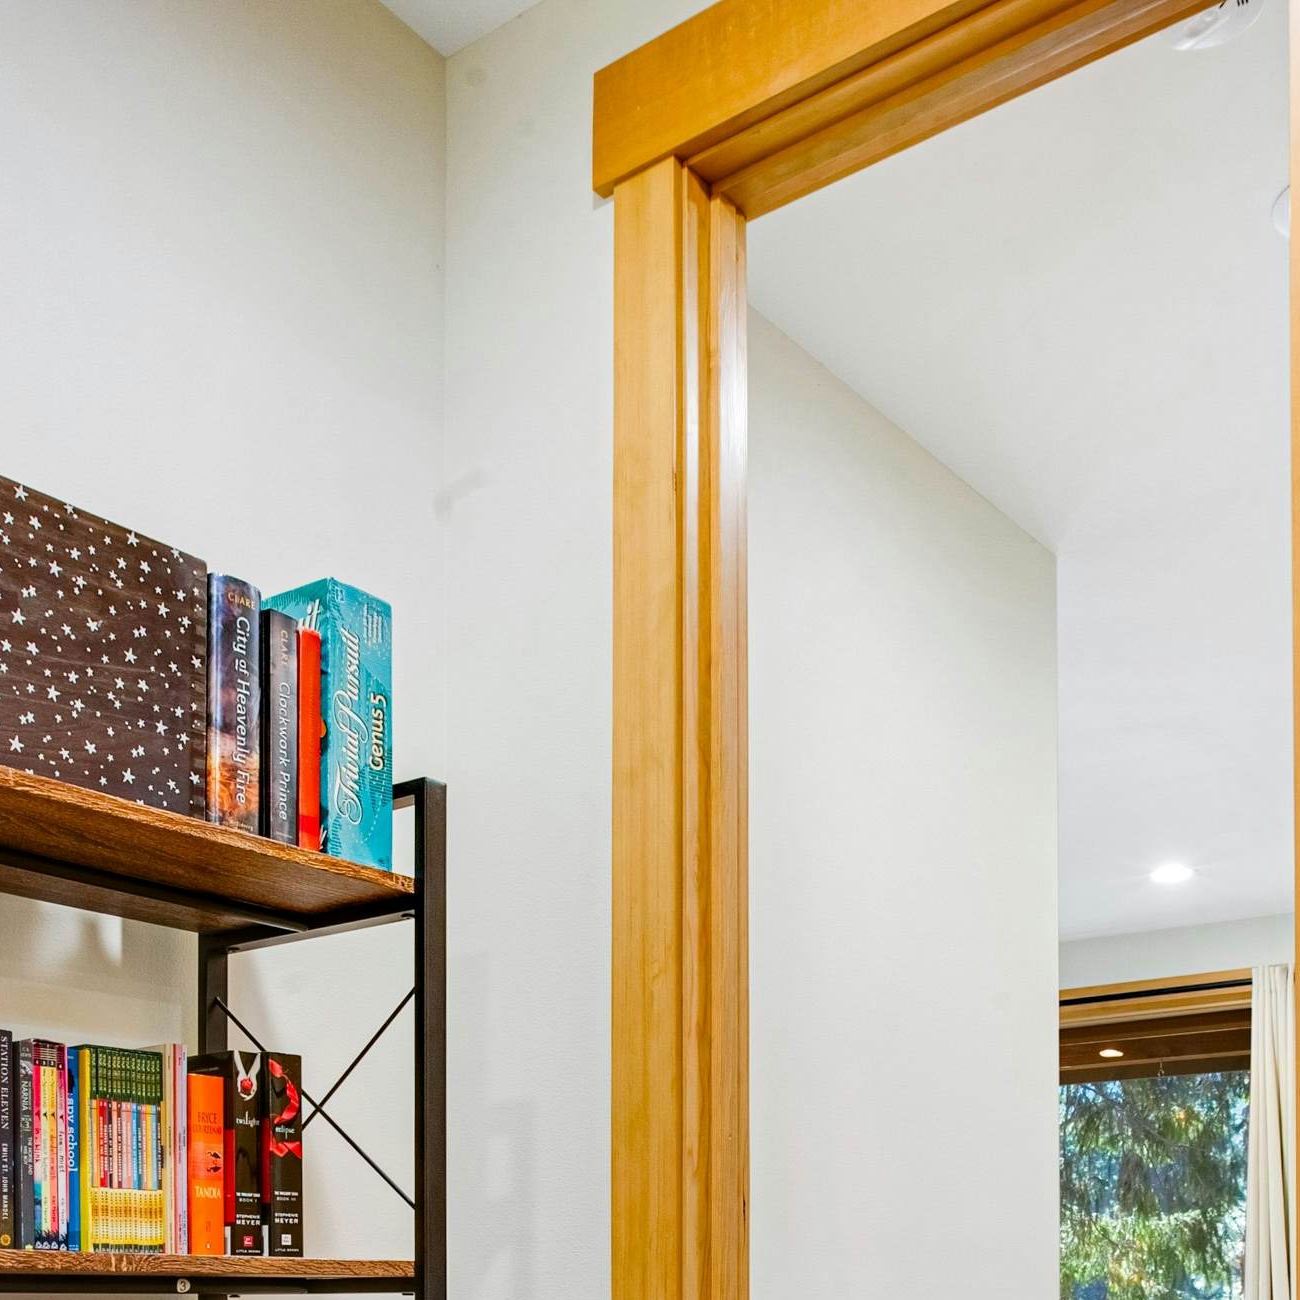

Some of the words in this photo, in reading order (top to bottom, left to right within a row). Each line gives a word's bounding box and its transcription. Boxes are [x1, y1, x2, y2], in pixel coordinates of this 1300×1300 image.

[233, 616, 251, 656] City
[235, 659, 251, 676] of
[332, 624, 369, 744] Pursuit
[370, 692, 388, 708] 5
[232, 679, 250, 765] Heavenly
[279, 682, 291, 767] Clockwork
[369, 709, 385, 771] Genus
[235, 769, 250, 805] Fire
[279, 771, 291, 821] Prince
[333, 728, 363, 825] Trivial
[0, 1035, 10, 1084] STATION
[0, 1087, 10, 1130] ELEVEN
[21, 1080, 29, 1111] NARNIA
[235, 1111, 260, 1128] twilight
[195, 1186, 222, 1199] TANDIA
